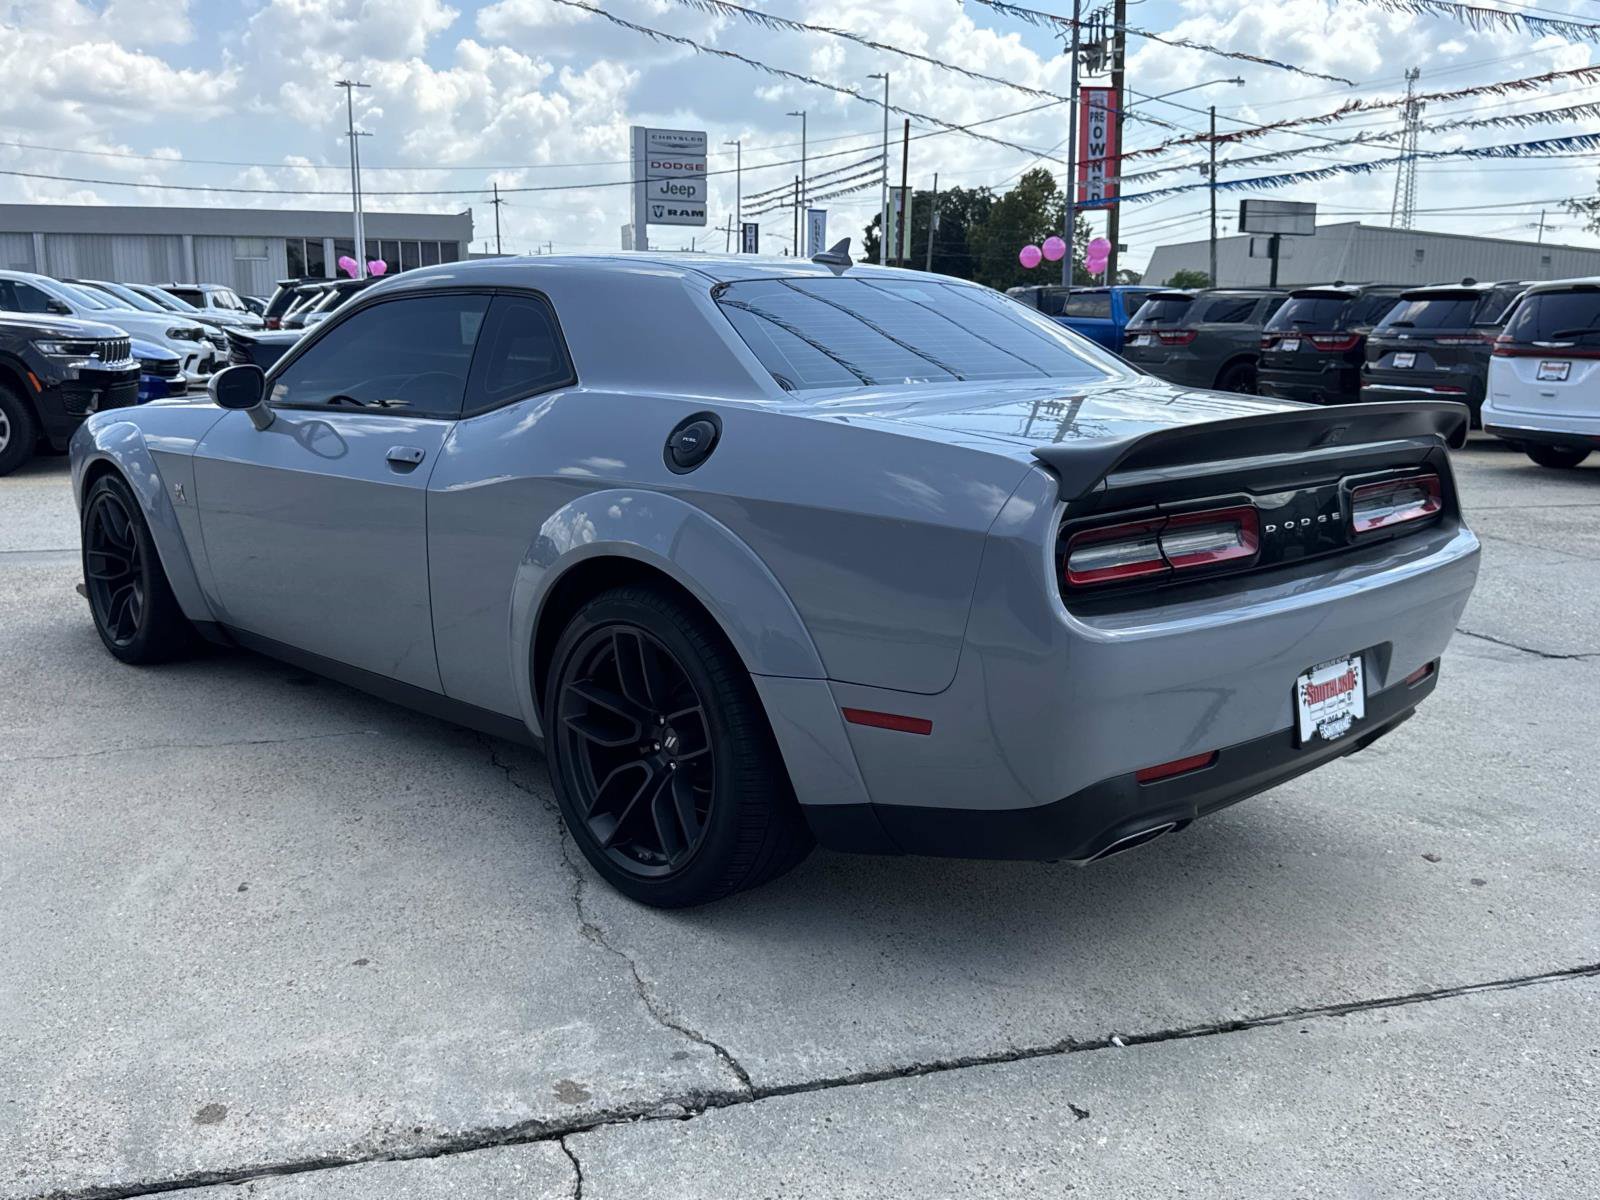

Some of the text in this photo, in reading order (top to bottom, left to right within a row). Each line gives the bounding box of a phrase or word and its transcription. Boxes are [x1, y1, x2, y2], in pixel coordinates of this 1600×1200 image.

[651, 134, 703, 143] CHRYSLER
[650, 161, 704, 171] DODGE
[660, 181, 696, 198] Jeep
[667, 209, 704, 217] RAM
[1265, 512, 1341, 533] DODGE
[1306, 669, 1356, 706] SOUTHLAND
